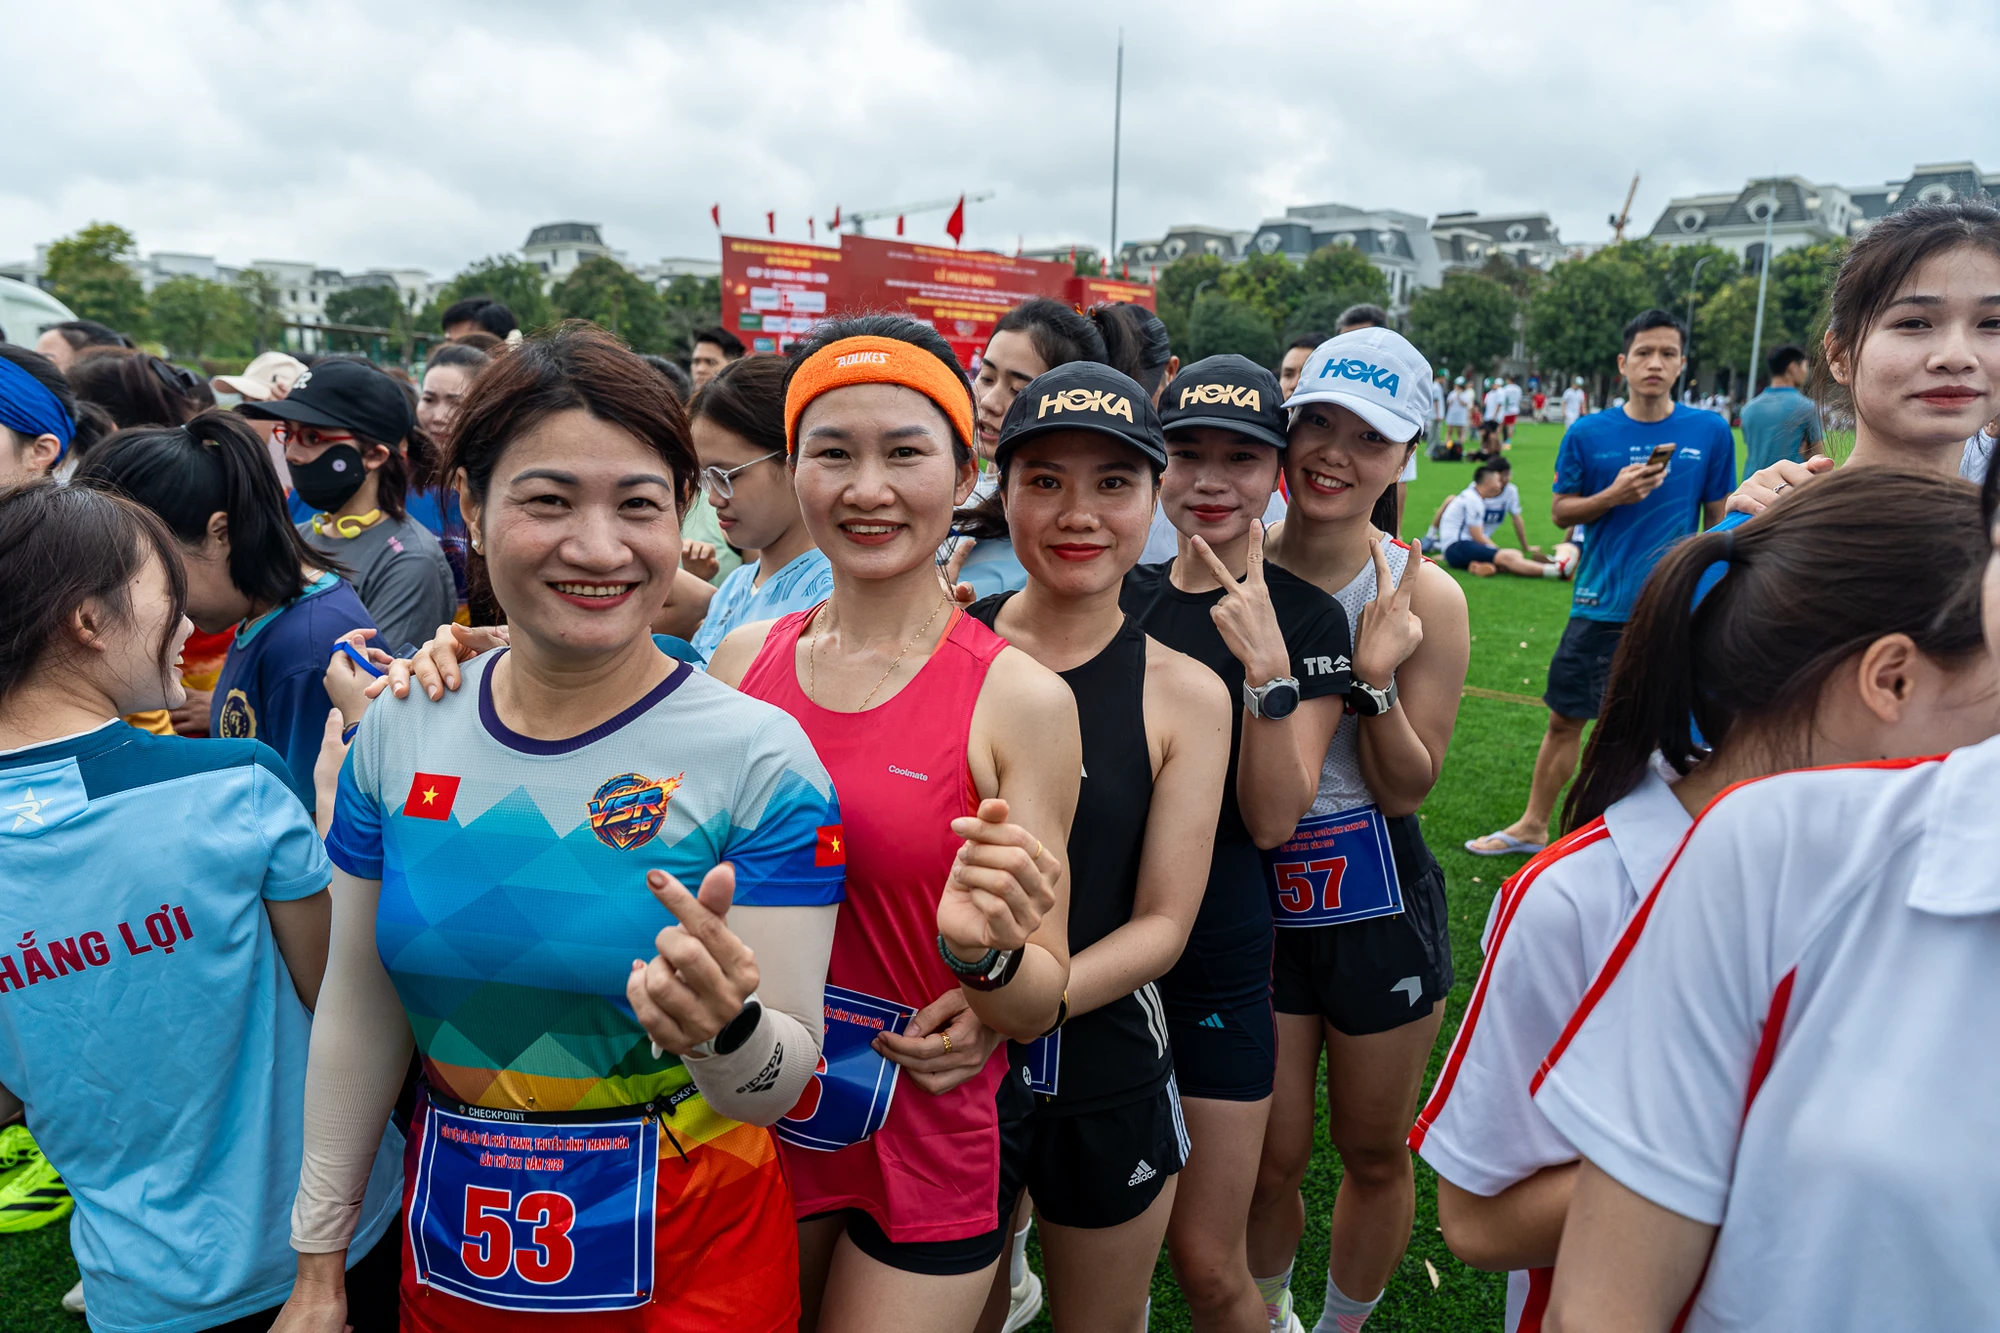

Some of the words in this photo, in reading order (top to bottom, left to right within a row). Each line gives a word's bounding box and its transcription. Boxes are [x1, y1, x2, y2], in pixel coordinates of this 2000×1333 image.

[1319, 358, 1400, 398] HOKA
[1037, 388, 1134, 424] HOKA
[1179, 384, 1261, 412] HOKA
[888, 764, 928, 782] Coolmate
[588, 787, 663, 828] VSR
[1274, 855, 1348, 913] 57
[0, 929, 111, 994] HẮNG
[117, 903, 194, 956] LỢI
[468, 1107, 526, 1122] CHECKPOINT
[490, 1132, 508, 1149] PHÁT
[508, 1136, 533, 1152] THANH,
[534, 1135, 564, 1152] TRUYỀN
[564, 1136, 585, 1152] HÌNH
[585, 1137, 612, 1152] THANH
[612, 1134, 630, 1150] HÓA
[508, 1156, 522, 1170] XXX
[524, 1154, 544, 1172] NĂM
[544, 1158, 564, 1172] 2026
[1128, 1169, 1157, 1187] adidas
[460, 1184, 576, 1285] 53
